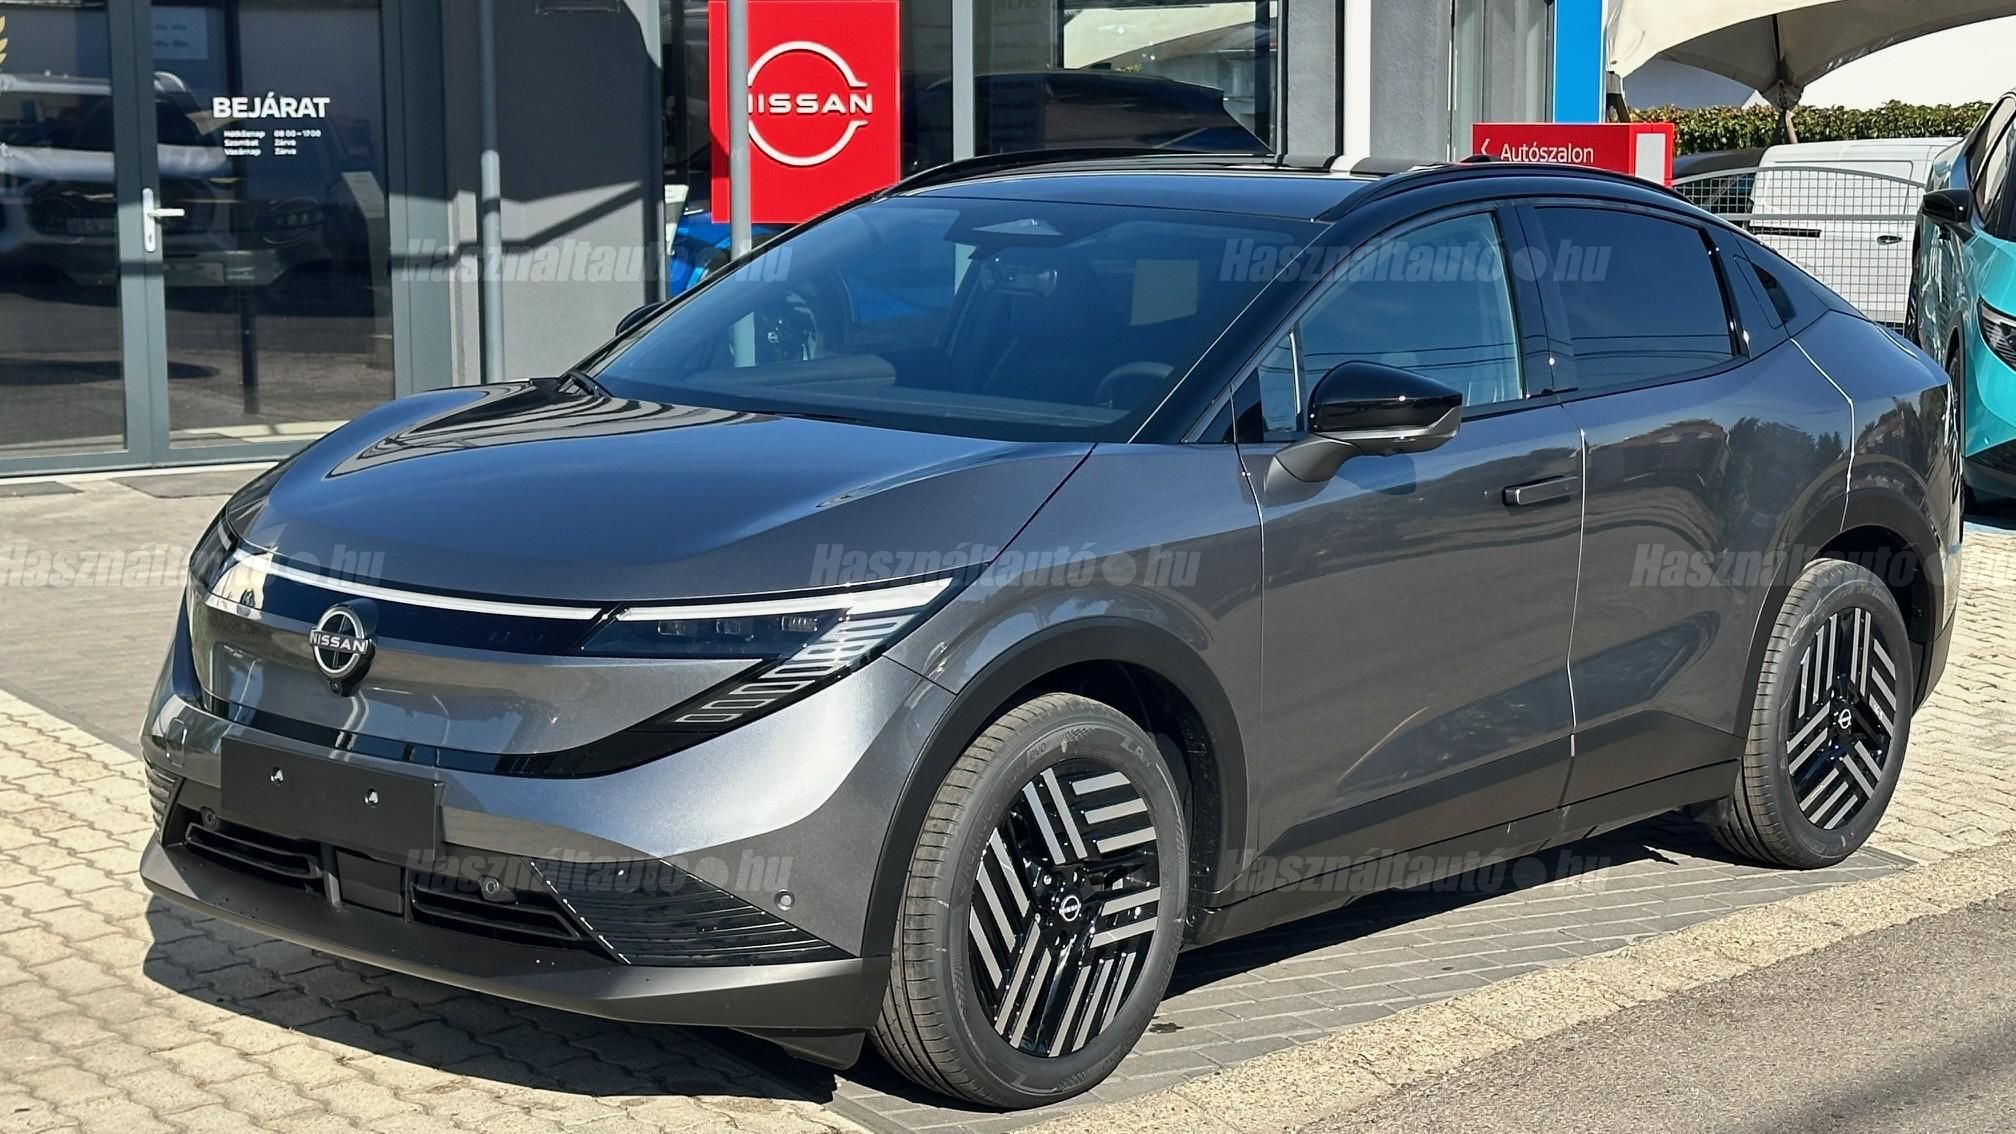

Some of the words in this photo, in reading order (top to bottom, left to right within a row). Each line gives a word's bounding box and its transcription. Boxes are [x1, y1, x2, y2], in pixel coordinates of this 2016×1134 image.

[212, 91, 330, 118] BEJÁRAT
[748, 93, 873, 114] ISSAN
[1500, 142, 1594, 163] Autószalon
[309, 632, 367, 653] NISSAN
